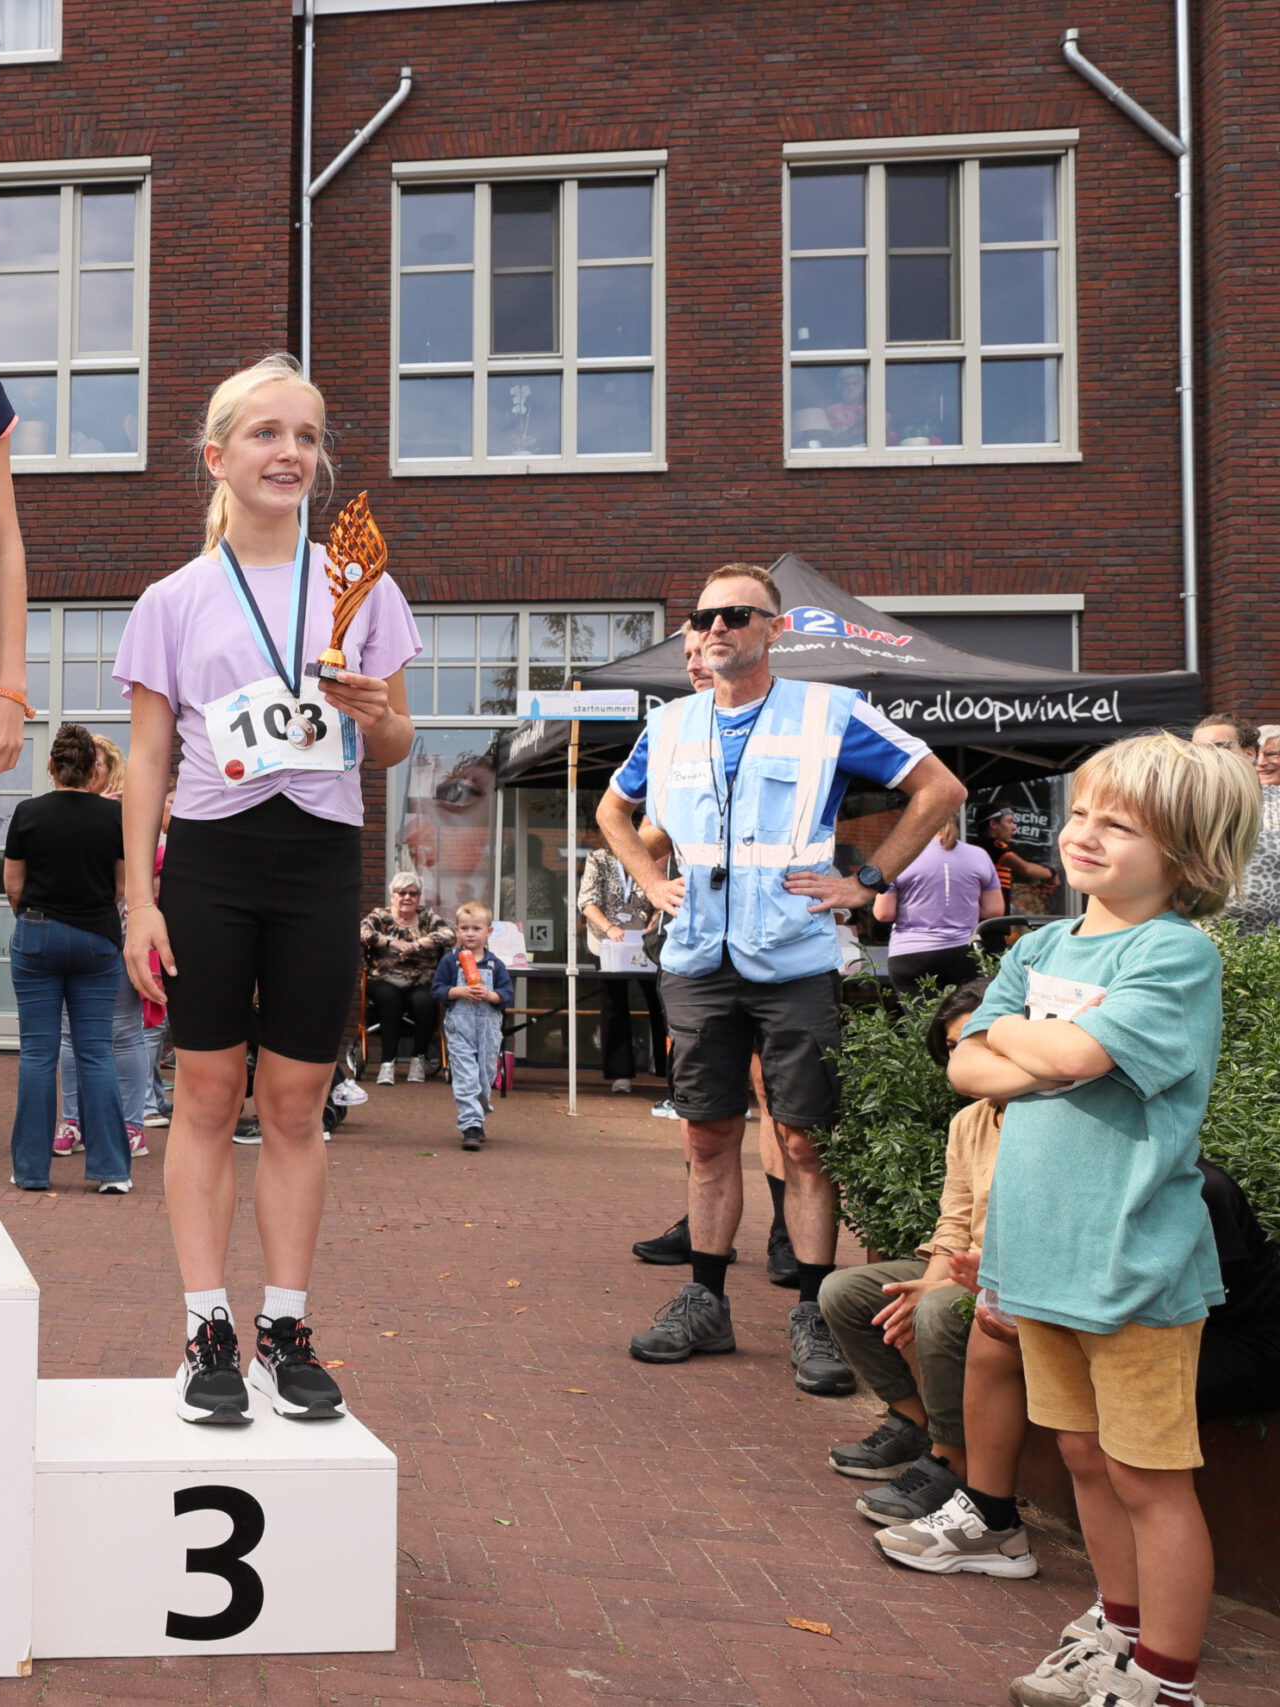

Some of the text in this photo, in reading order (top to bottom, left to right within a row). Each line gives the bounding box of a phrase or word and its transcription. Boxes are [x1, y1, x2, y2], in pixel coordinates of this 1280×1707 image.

[229, 702, 328, 749] 103
[572, 704, 636, 713] startnummers
[165, 1484, 266, 1641] 3
